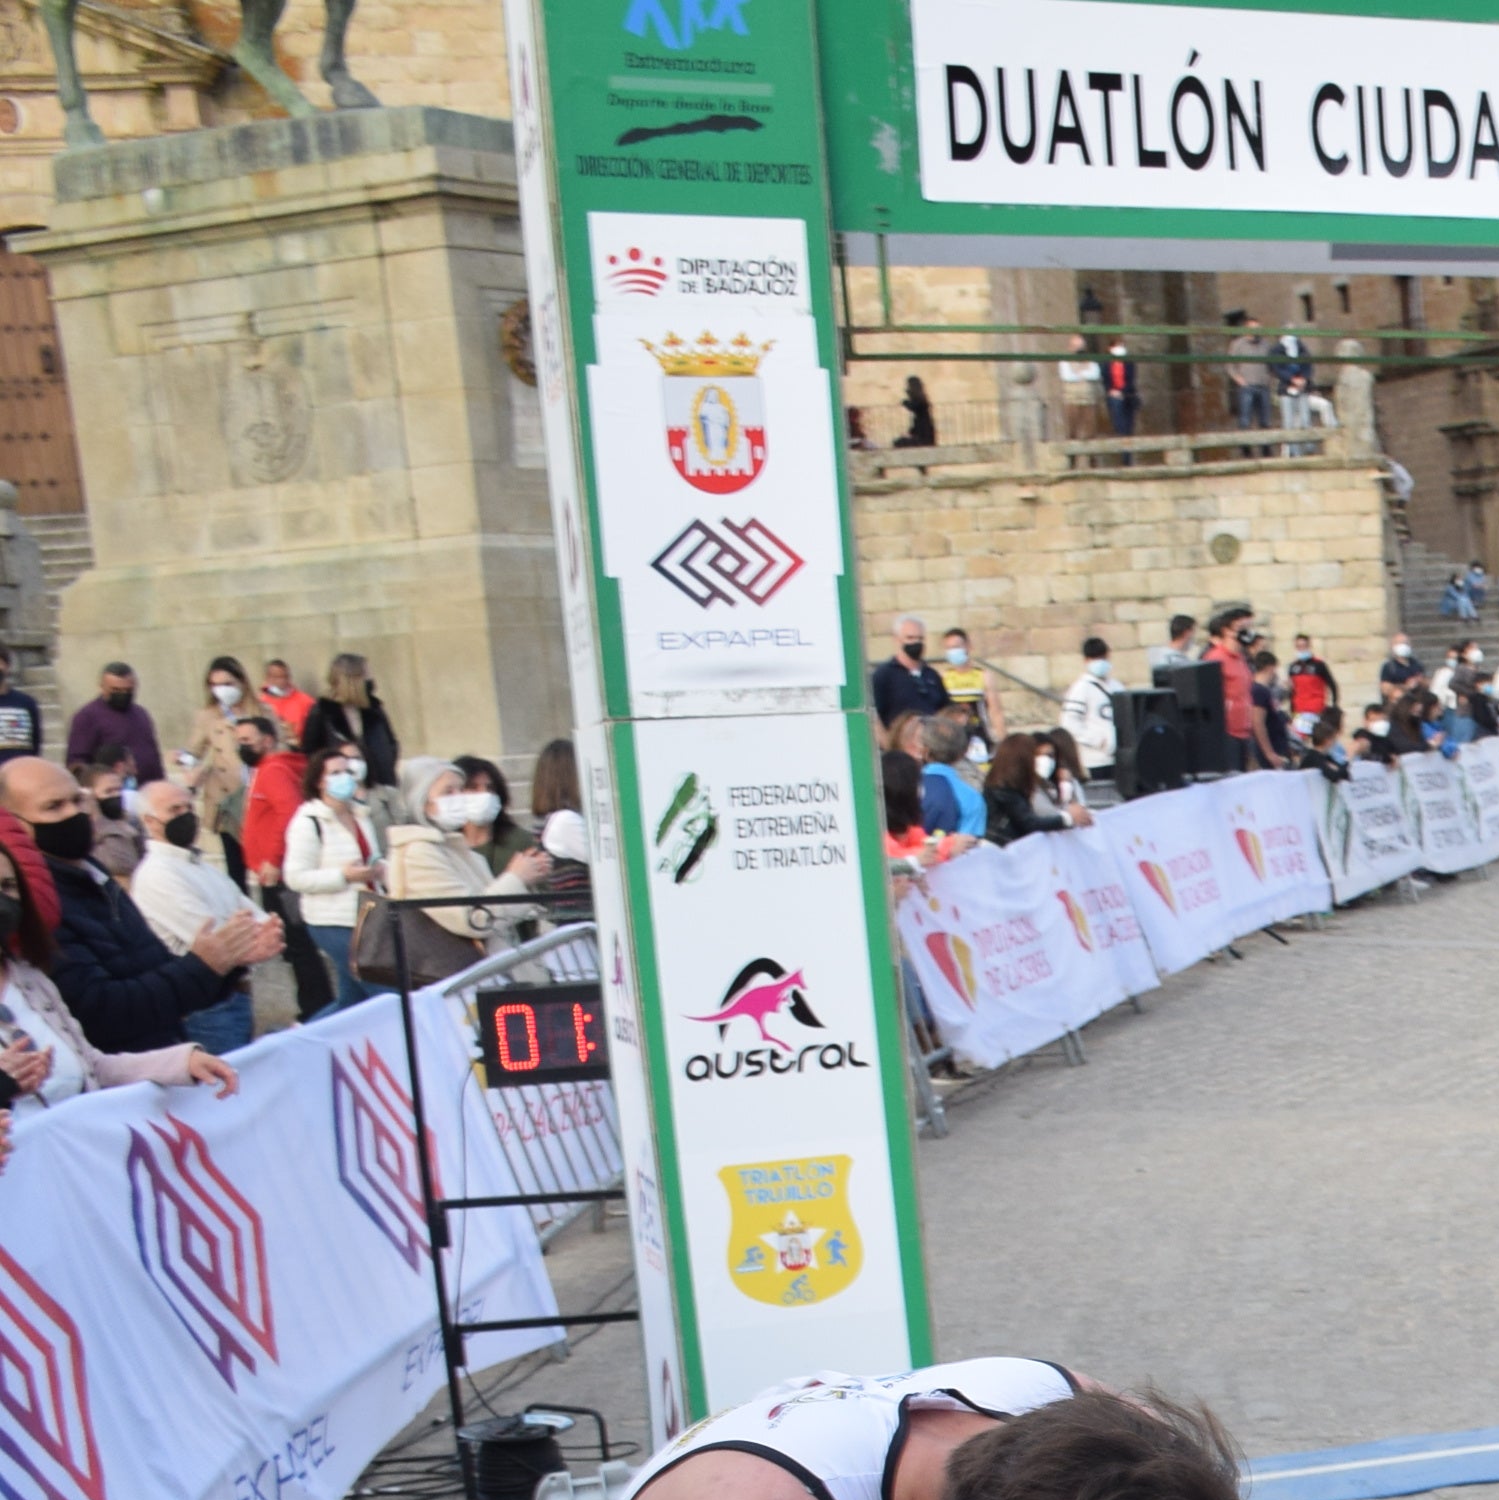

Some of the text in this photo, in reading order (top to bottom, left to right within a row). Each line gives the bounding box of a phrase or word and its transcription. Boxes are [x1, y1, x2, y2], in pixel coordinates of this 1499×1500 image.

[943, 47, 1268, 172] DUATLÓN
[679, 252, 796, 278] DIPUTACIÓN
[705, 277, 797, 296] BADAJOZ
[658, 628, 813, 652] EXPAPEL
[729, 777, 839, 808] FEDERACIÓN
[736, 812, 839, 839] EXTREMEÑA
[734, 842, 846, 871] DE TRIATLÓN
[685, 1041, 870, 1082] austral
[737, 1161, 836, 1186] TRIATLÓN
[743, 1182, 834, 1205] TRUJILLO
